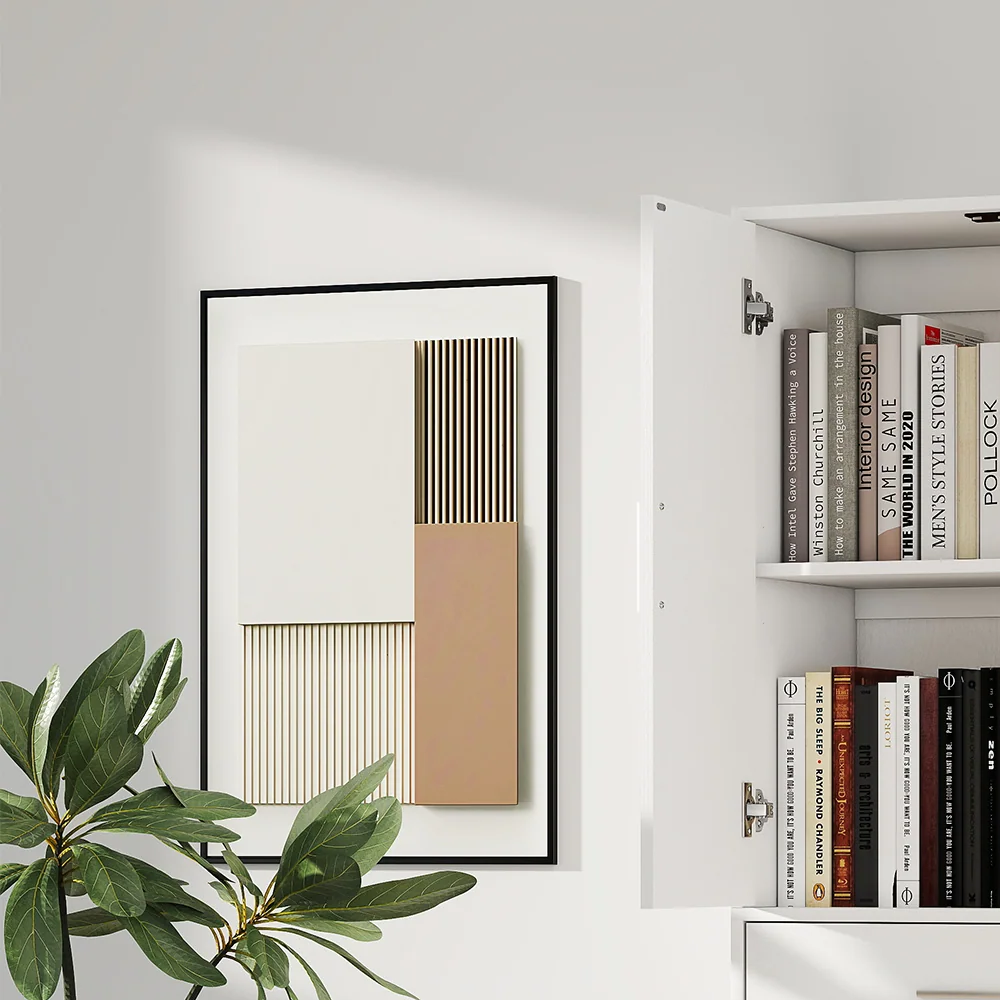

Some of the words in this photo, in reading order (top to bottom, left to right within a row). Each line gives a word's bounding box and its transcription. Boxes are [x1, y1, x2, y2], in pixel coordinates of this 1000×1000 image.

[834, 313, 844, 344] house
[834, 350, 844, 368] the
[834, 375, 844, 388] in
[858, 351, 877, 416] design
[931, 354, 946, 430] STORIES
[788, 381, 799, 424] Hawking
[835, 394, 846, 462] arrangement
[881, 398, 897, 452] SAME
[902, 410, 914, 451] 2020
[788, 429, 799, 472] Stephen
[812, 408, 824, 486] Churchill
[858, 422, 872, 490] Interior
[902, 454, 914, 470] IN
[931, 433, 946, 490] STYLE
[983, 399, 998, 505] POLLOCK
[788, 477, 797, 502] Gave
[836, 468, 844, 481] an
[834, 486, 844, 512] make
[881, 465, 897, 518] SAME
[902, 473, 914, 528] WORLD
[788, 508, 797, 538] Intel
[812, 495, 824, 556] Winston
[835, 517, 844, 530] to
[931, 494, 946, 549] MEN'S
[788, 543, 797, 562] How
[834, 536, 844, 556] How
[902, 530, 914, 558] THE
[815, 686, 824, 704] THE
[815, 707, 824, 724] BIG
[945, 706, 953, 721] Arden
[945, 722, 953, 734] Paul
[786, 728, 795, 740] Paul
[815, 728, 824, 755] SLEEP
[858, 745, 873, 766] arts
[815, 768, 824, 820] RAYMOND
[858, 784, 874, 850] architecture
[815, 823, 824, 875] CHANDLER
[903, 845, 911, 856] Paul
[903, 857, 911, 871] Arden
